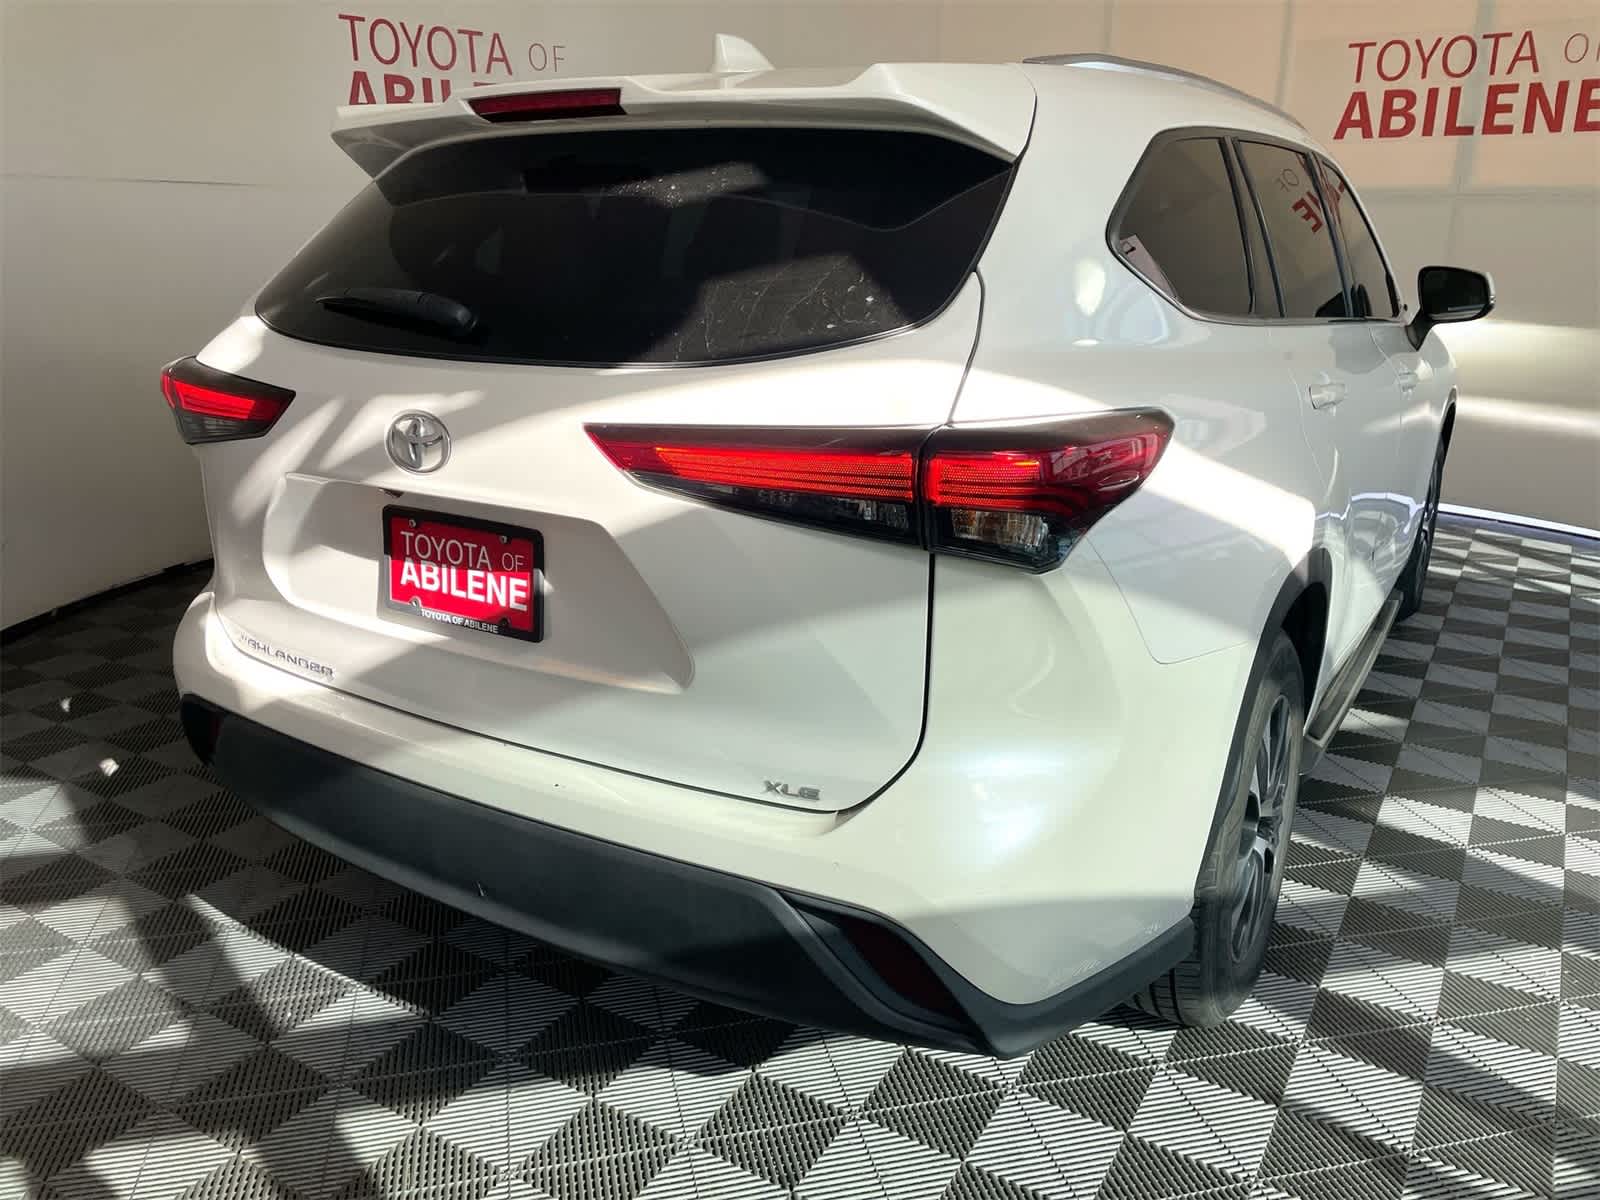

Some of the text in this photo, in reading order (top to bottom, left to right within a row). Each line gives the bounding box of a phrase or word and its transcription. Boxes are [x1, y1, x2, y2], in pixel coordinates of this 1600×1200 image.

[338, 14, 565, 76] TOYOTA OF
[1348, 30, 1600, 83] TOYOTA O
[1333, 78, 1600, 140] ABILENE
[400, 531, 525, 572] TOYOTA OF
[400, 557, 528, 611] ABILENE
[421, 608, 499, 634] TOYOTA OF ABILENE
[764, 780, 820, 800] XLE
